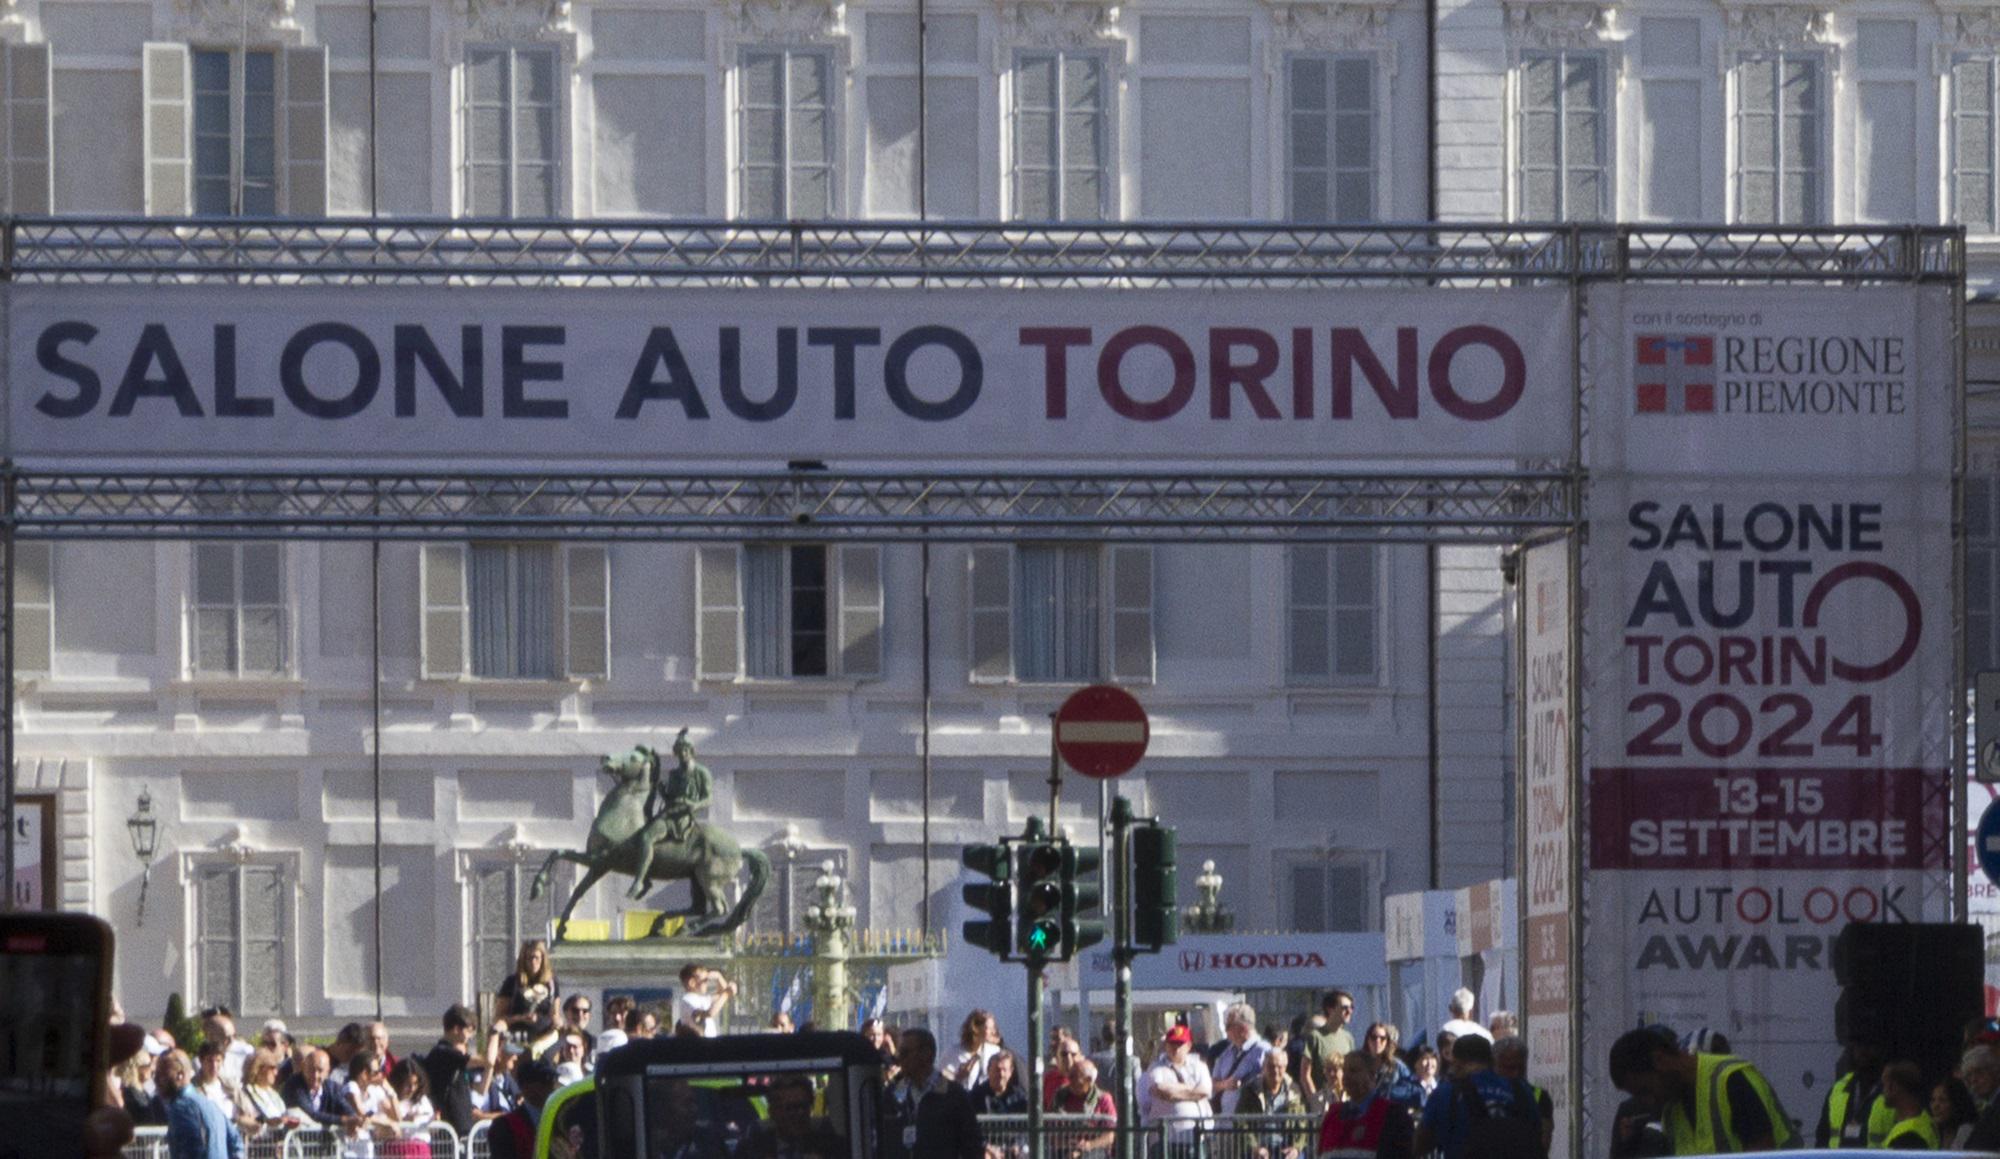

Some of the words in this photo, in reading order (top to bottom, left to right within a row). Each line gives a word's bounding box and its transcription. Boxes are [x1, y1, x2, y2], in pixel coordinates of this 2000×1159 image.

[1633, 313, 1661, 326] con
[1676, 313, 1746, 329] sostegno
[33, 320, 571, 420] SALONE
[614, 323, 984, 423] AUTO
[1018, 323, 1527, 423] TORINO
[1724, 336, 1905, 376] REGIONE
[1724, 380, 1905, 415] PIEMONTE
[1627, 501, 1884, 553] SALONE
[1626, 561, 1923, 682] AUTO
[1625, 693, 1883, 758] 2024
[1712, 777, 1825, 815] 13-15
[1629, 819, 1907, 856] SETTEMBRE
[1637, 886, 1911, 924] AUTOLOOK
[1210, 952, 1326, 969] HONDA
[1636, 935, 1836, 969] AWAR
